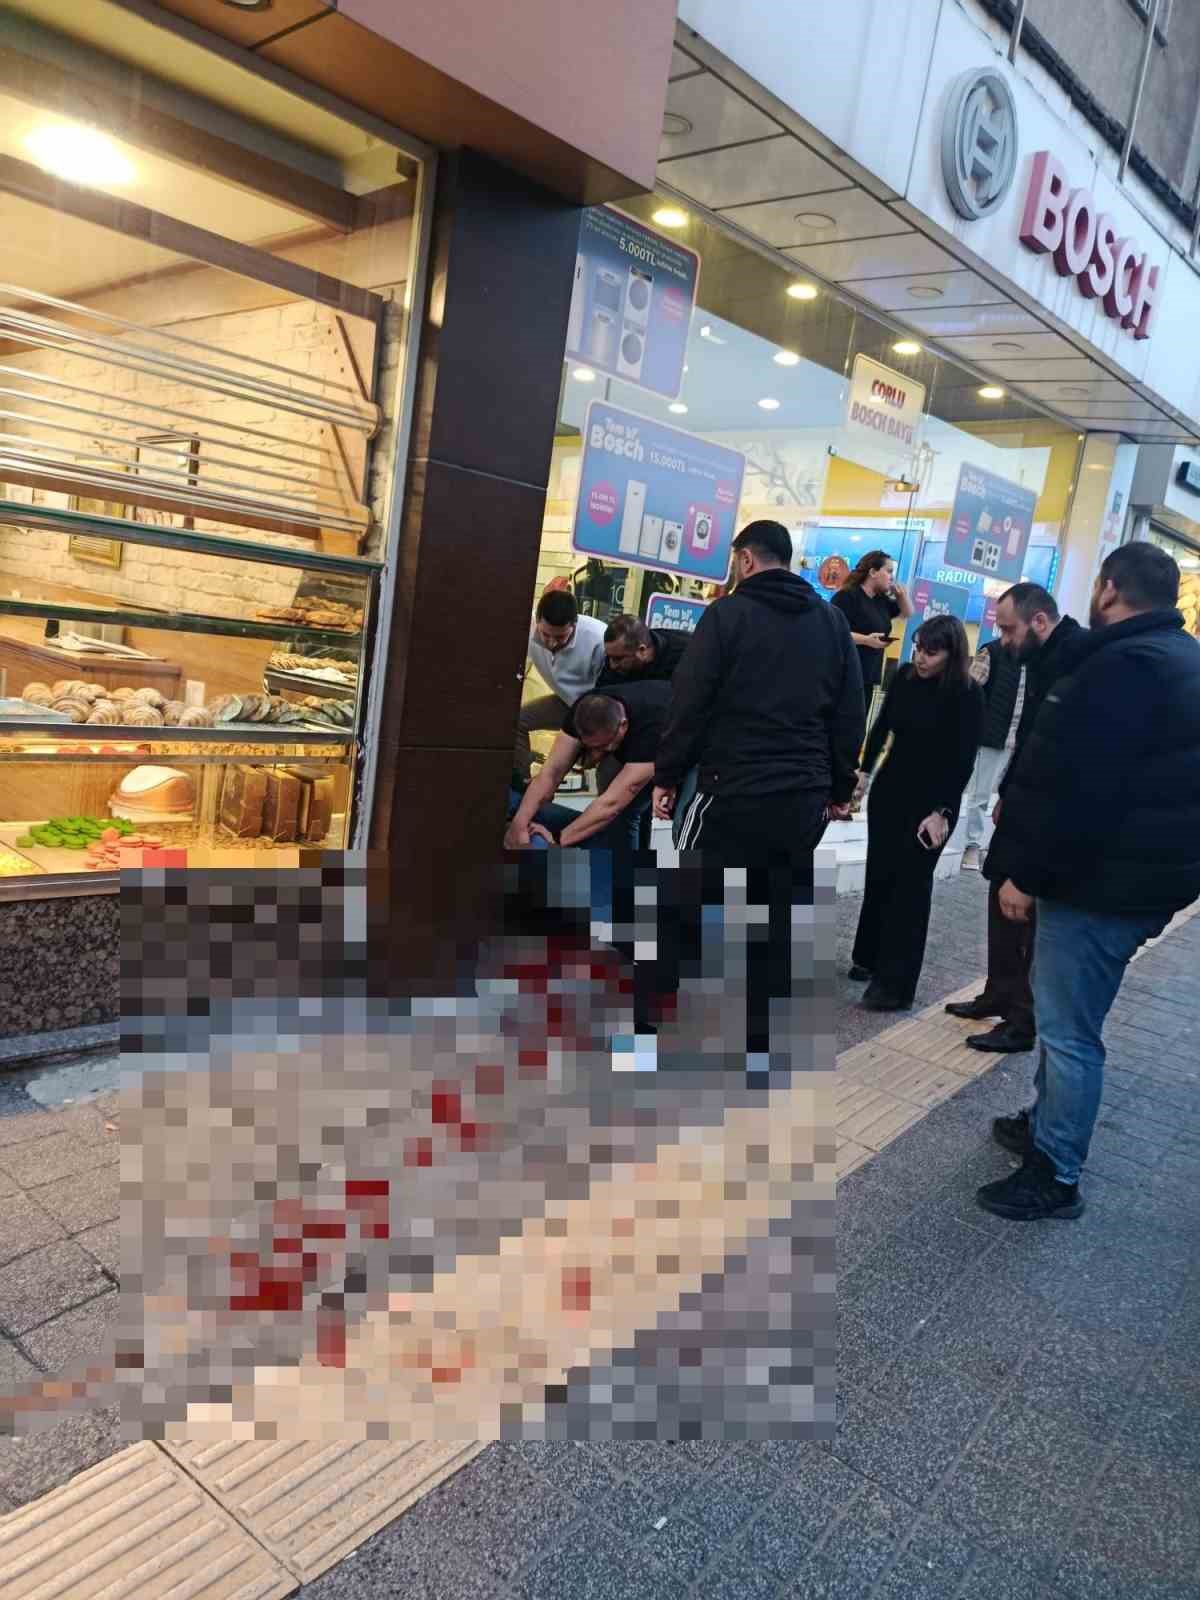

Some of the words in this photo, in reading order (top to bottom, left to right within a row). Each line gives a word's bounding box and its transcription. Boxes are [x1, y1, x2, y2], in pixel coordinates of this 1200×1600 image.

[1019, 150, 1160, 340] BOSCH
[851, 400, 888, 433] BOSCH
[590, 423, 644, 463] Bosch
